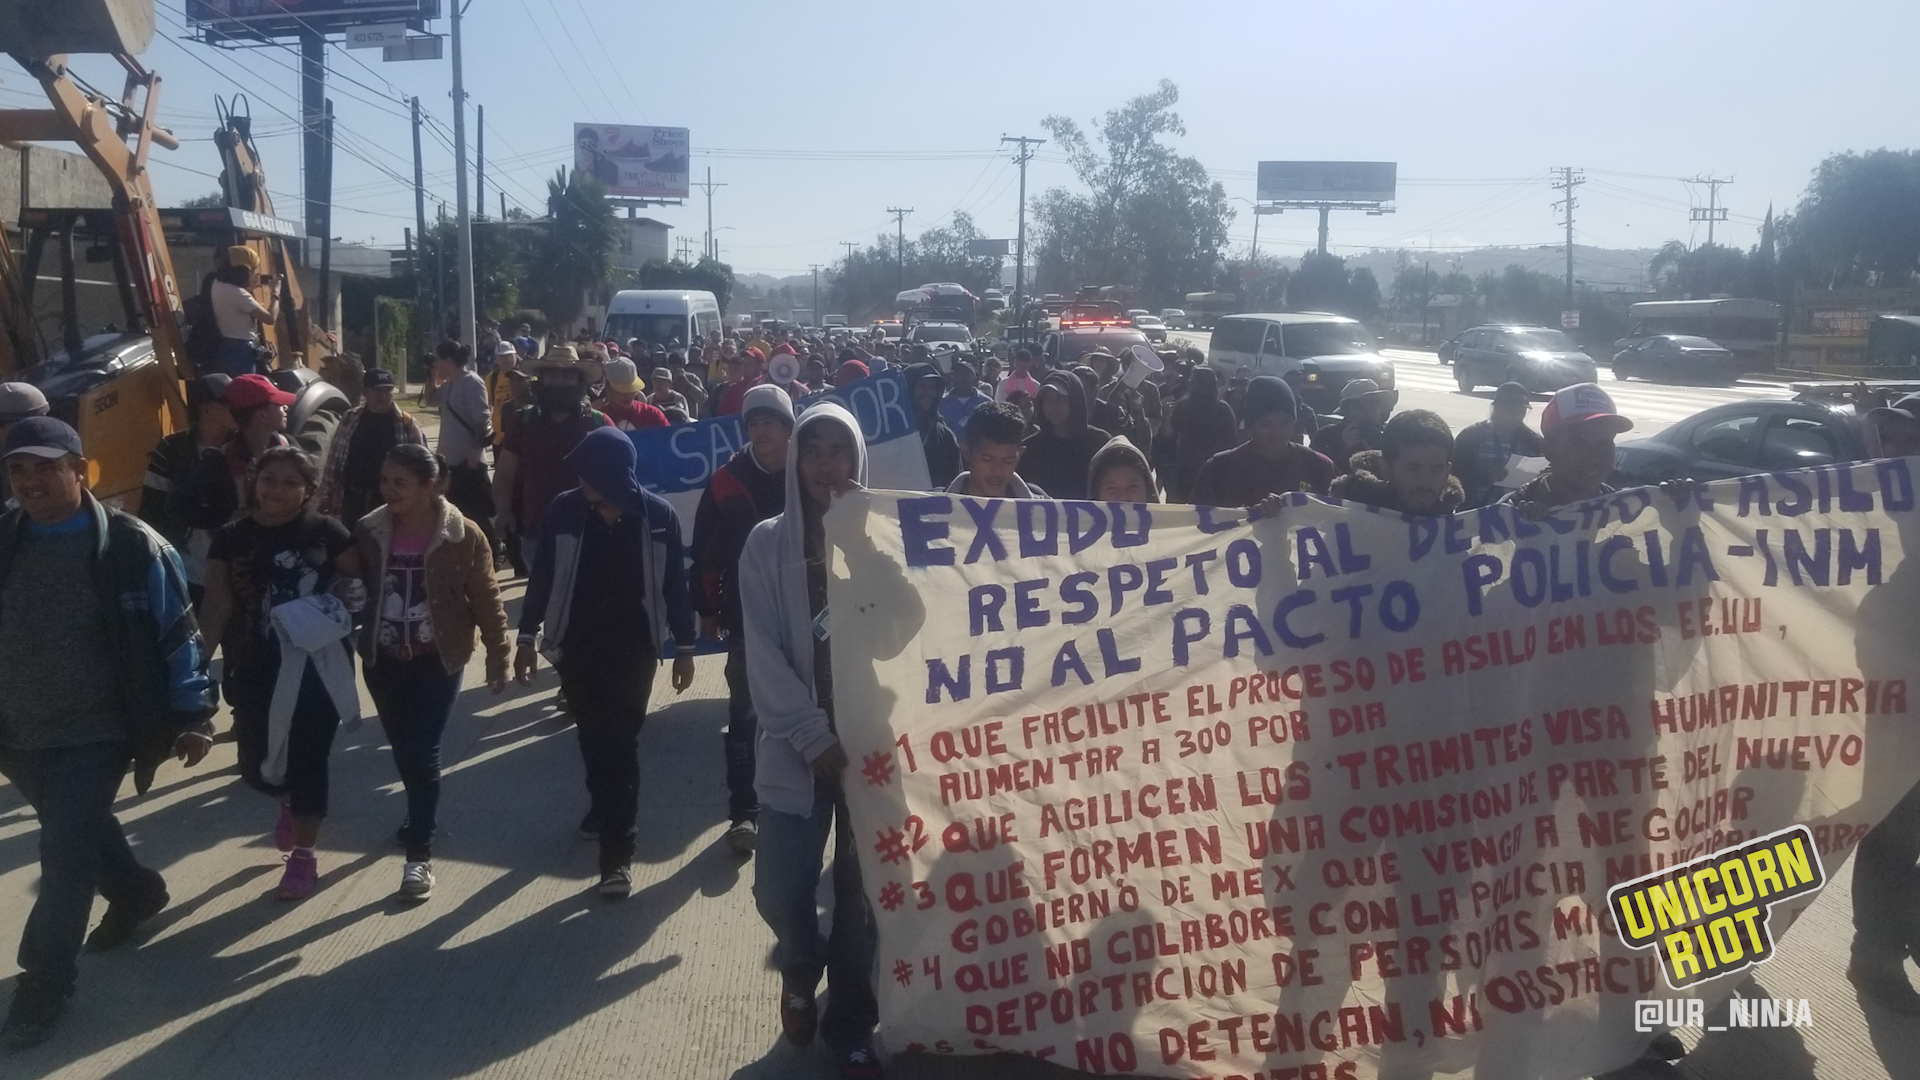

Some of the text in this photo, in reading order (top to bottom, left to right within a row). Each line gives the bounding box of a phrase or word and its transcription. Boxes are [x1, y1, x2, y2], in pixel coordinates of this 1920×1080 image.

[968, 539, 1262, 636] RESPETO
[1296, 522, 1371, 580] AL
[1737, 458, 1914, 518] ASILO
[861, 733, 918, 787] #1
[930, 721, 1007, 764] QUE
[1022, 692, 1171, 749] FACILITE
[1187, 684, 1222, 717] EL
[1228, 656, 1375, 710] PROCESO
[1387, 647, 1426, 686] DE
[1442, 625, 1536, 676] ASILO
[1547, 614, 1586, 654] EN
[1596, 605, 1661, 646] LOS
[925, 645, 1025, 704] NO
[1051, 627, 1141, 687] AL
[1172, 579, 1420, 666] PACTO
[874, 678, 1907, 865] #2 QUE AGILICEN LOS TRAMITES VISA HUMANITARIA
[939, 701, 1387, 806] AUMENTAR A 300 POR DIA
[879, 734, 1864, 913] #3 QUE FORMEN UNA COMISION DE PARTE DEL NUEVO
[951, 879, 1139, 954] GOBIERNO
[1161, 875, 1194, 906] DE
[1211, 865, 1296, 901] MEX
[1322, 852, 1401, 888] QUE
[1421, 822, 1523, 876] VENGA
[1535, 814, 1560, 848] A
[892, 954, 943, 991] #4
[954, 952, 1029, 993] QUE
[1045, 938, 1092, 980] NO
[1107, 904, 1296, 965] COLABORE
[1308, 897, 1400, 936] CON
[1410, 886, 1459, 927] LA
[1471, 861, 1586, 919] POLICIA
[966, 958, 1247, 1036] DEPORTACION
[1272, 948, 1323, 988] DE
[1075, 1032, 1138, 1075] NO
[1430, 993, 1484, 1038] NI
